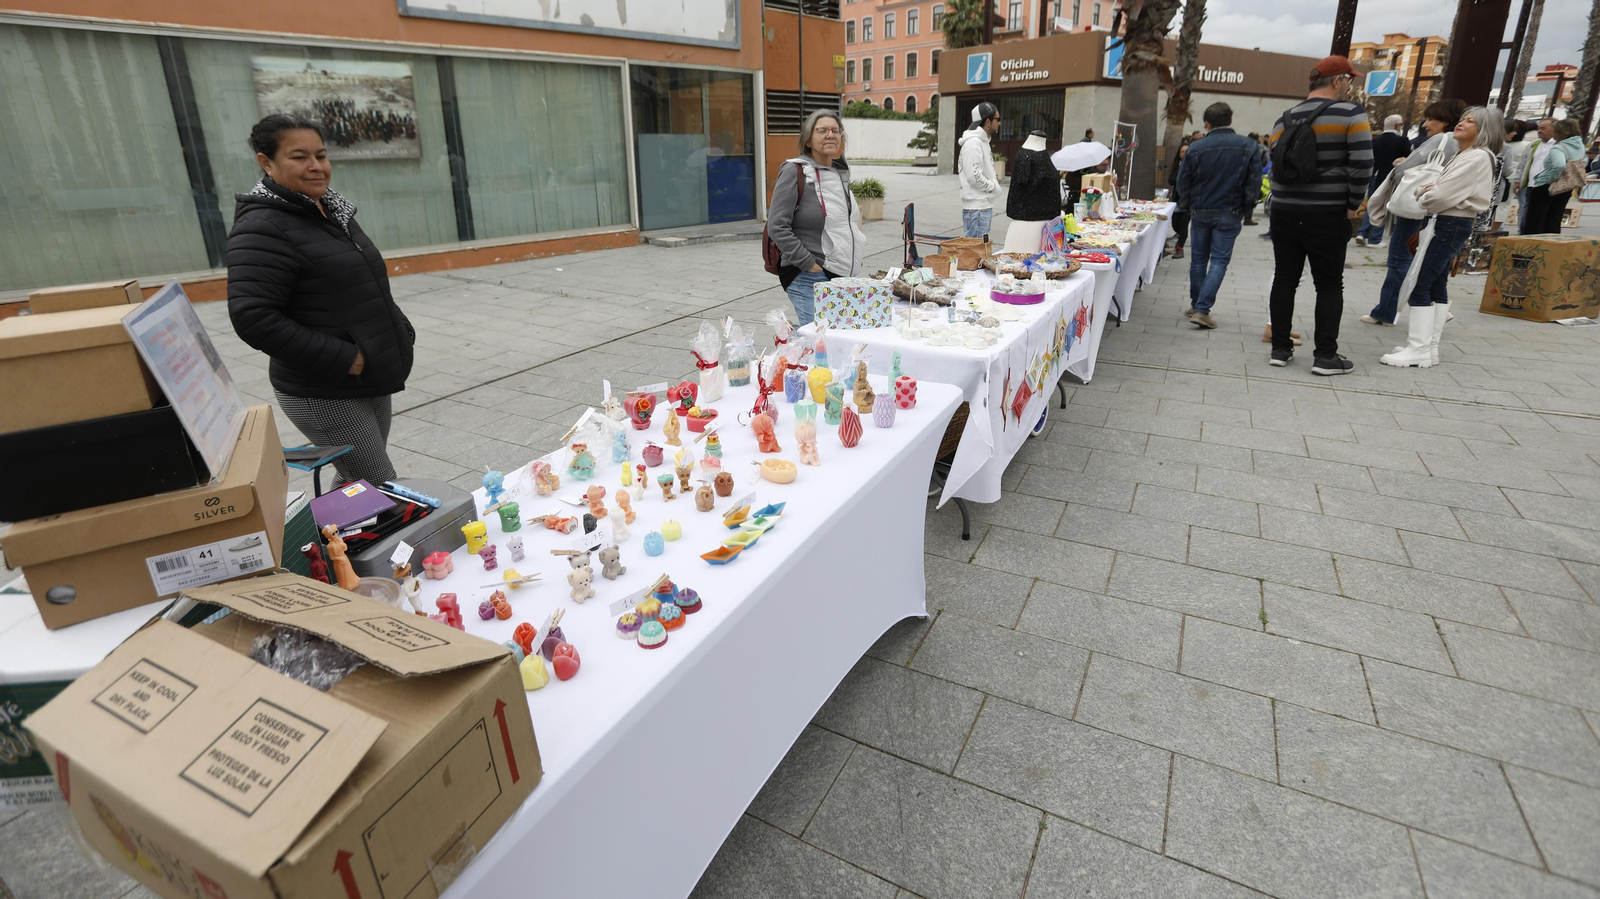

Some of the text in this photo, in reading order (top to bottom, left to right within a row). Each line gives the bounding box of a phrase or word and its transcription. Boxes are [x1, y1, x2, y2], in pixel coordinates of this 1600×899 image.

[1000, 58, 1035, 71] Oficina
[1197, 65, 1244, 84] Turismo
[1000, 69, 1050, 83] de Turismo
[504, 488, 521, 501] 2,50
[194, 505, 236, 521] SILVER
[582, 530, 604, 547] 2,75
[199, 549, 213, 559] 41
[363, 621, 419, 648] KEEP IN COOL
[386, 621, 432, 643] DRY PLACE
[389, 629, 409, 638] AND
[129, 670, 179, 702] KEEP IN COOL
[132, 689, 151, 702] AND
[109, 693, 151, 721] DRY PLACE
[249, 724, 289, 750] EN LUGAR
[253, 712, 305, 743] CONSERVESE
[230, 729, 291, 766] SECO Y FRESCO
[207, 748, 273, 789] PROTEGER DE LA
[207, 764, 251, 794] LUZ SOLAR
